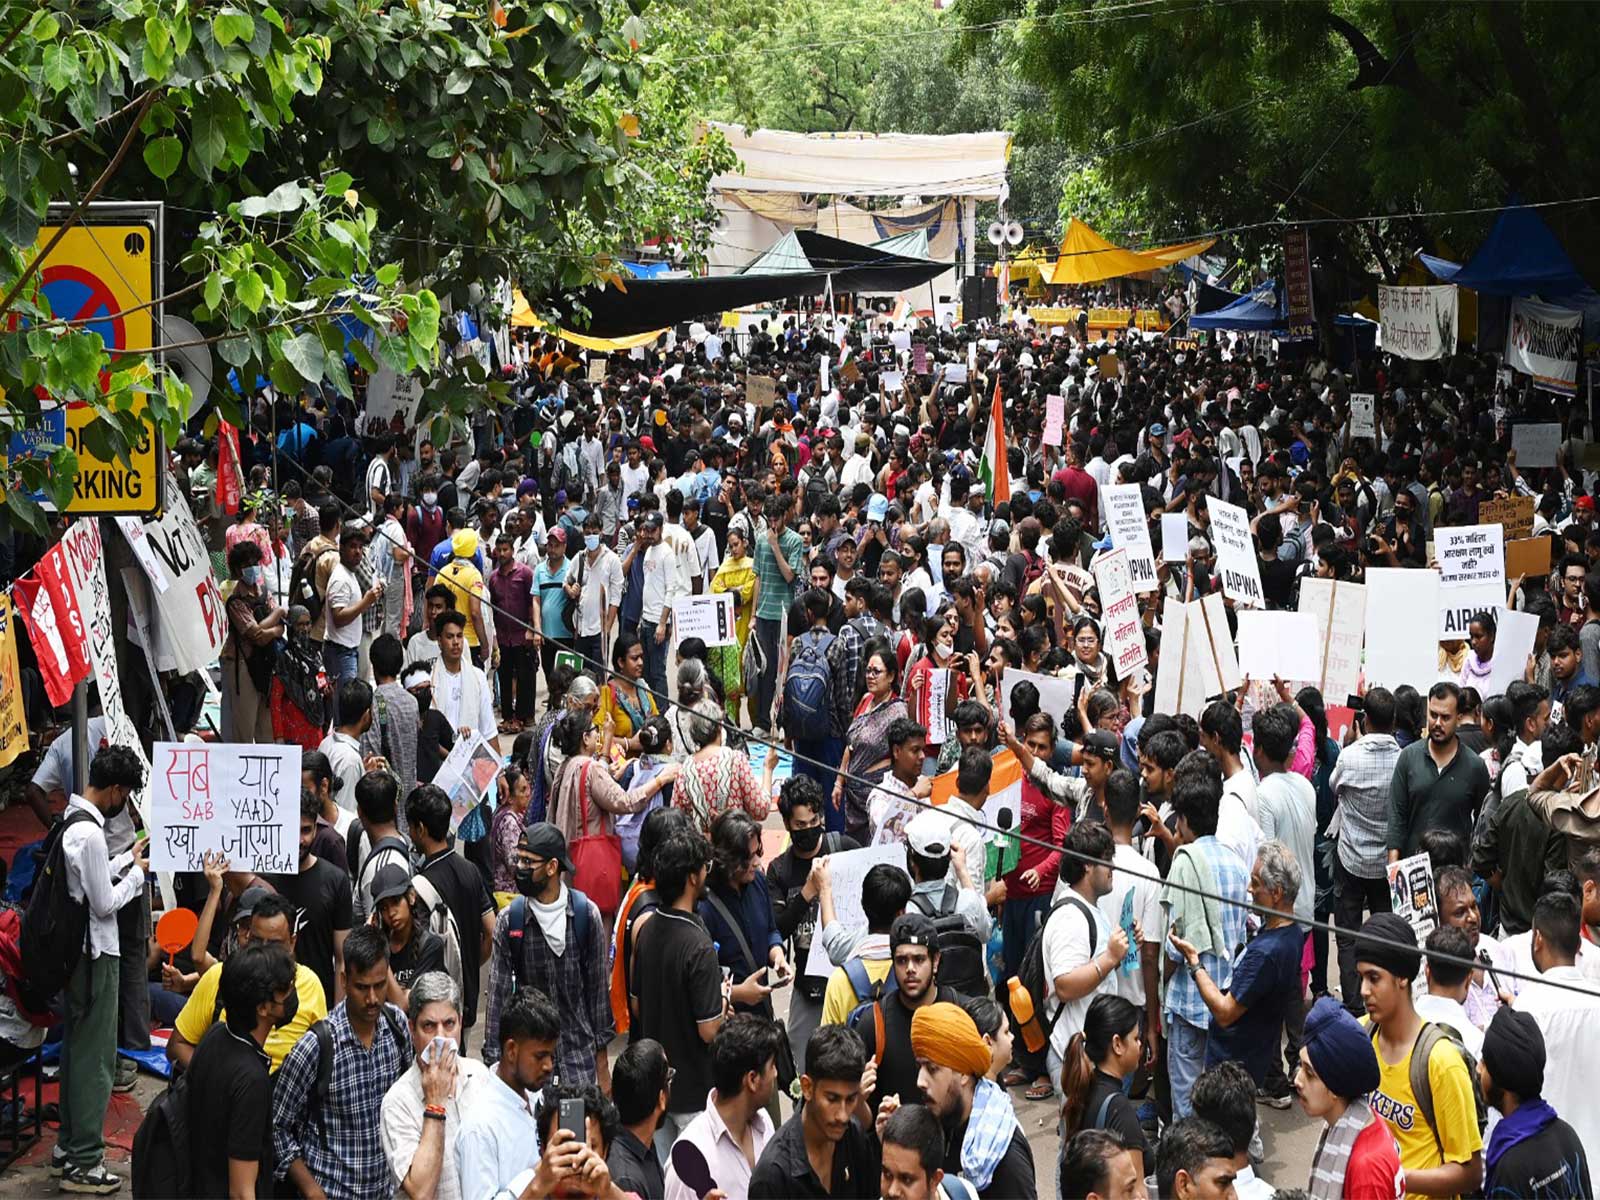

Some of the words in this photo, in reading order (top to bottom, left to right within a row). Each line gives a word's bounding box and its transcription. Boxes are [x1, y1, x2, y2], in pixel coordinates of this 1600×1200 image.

[1290, 325, 1313, 336] KYS
[74, 470, 142, 499] RKING
[1449, 536, 1464, 546] 33%
[1465, 531, 1487, 543] महिला
[1468, 546, 1483, 559] लागू
[1067, 571, 1088, 589] ONLY
[1129, 557, 1154, 581] IPWA
[1226, 569, 1260, 599] AIPWA
[52, 551, 91, 665] PDSU
[1107, 591, 1135, 619] जनवादी
[1114, 621, 1137, 642] महिला
[1118, 642, 1142, 668] समिति
[166, 749, 210, 800] सब
[238, 755, 283, 806] याद
[182, 800, 214, 821] SAB
[230, 797, 274, 823] YAAD
[164, 825, 200, 858] रखा
[221, 824, 283, 859] जाएगा
[250, 853, 293, 872] JAEGA
